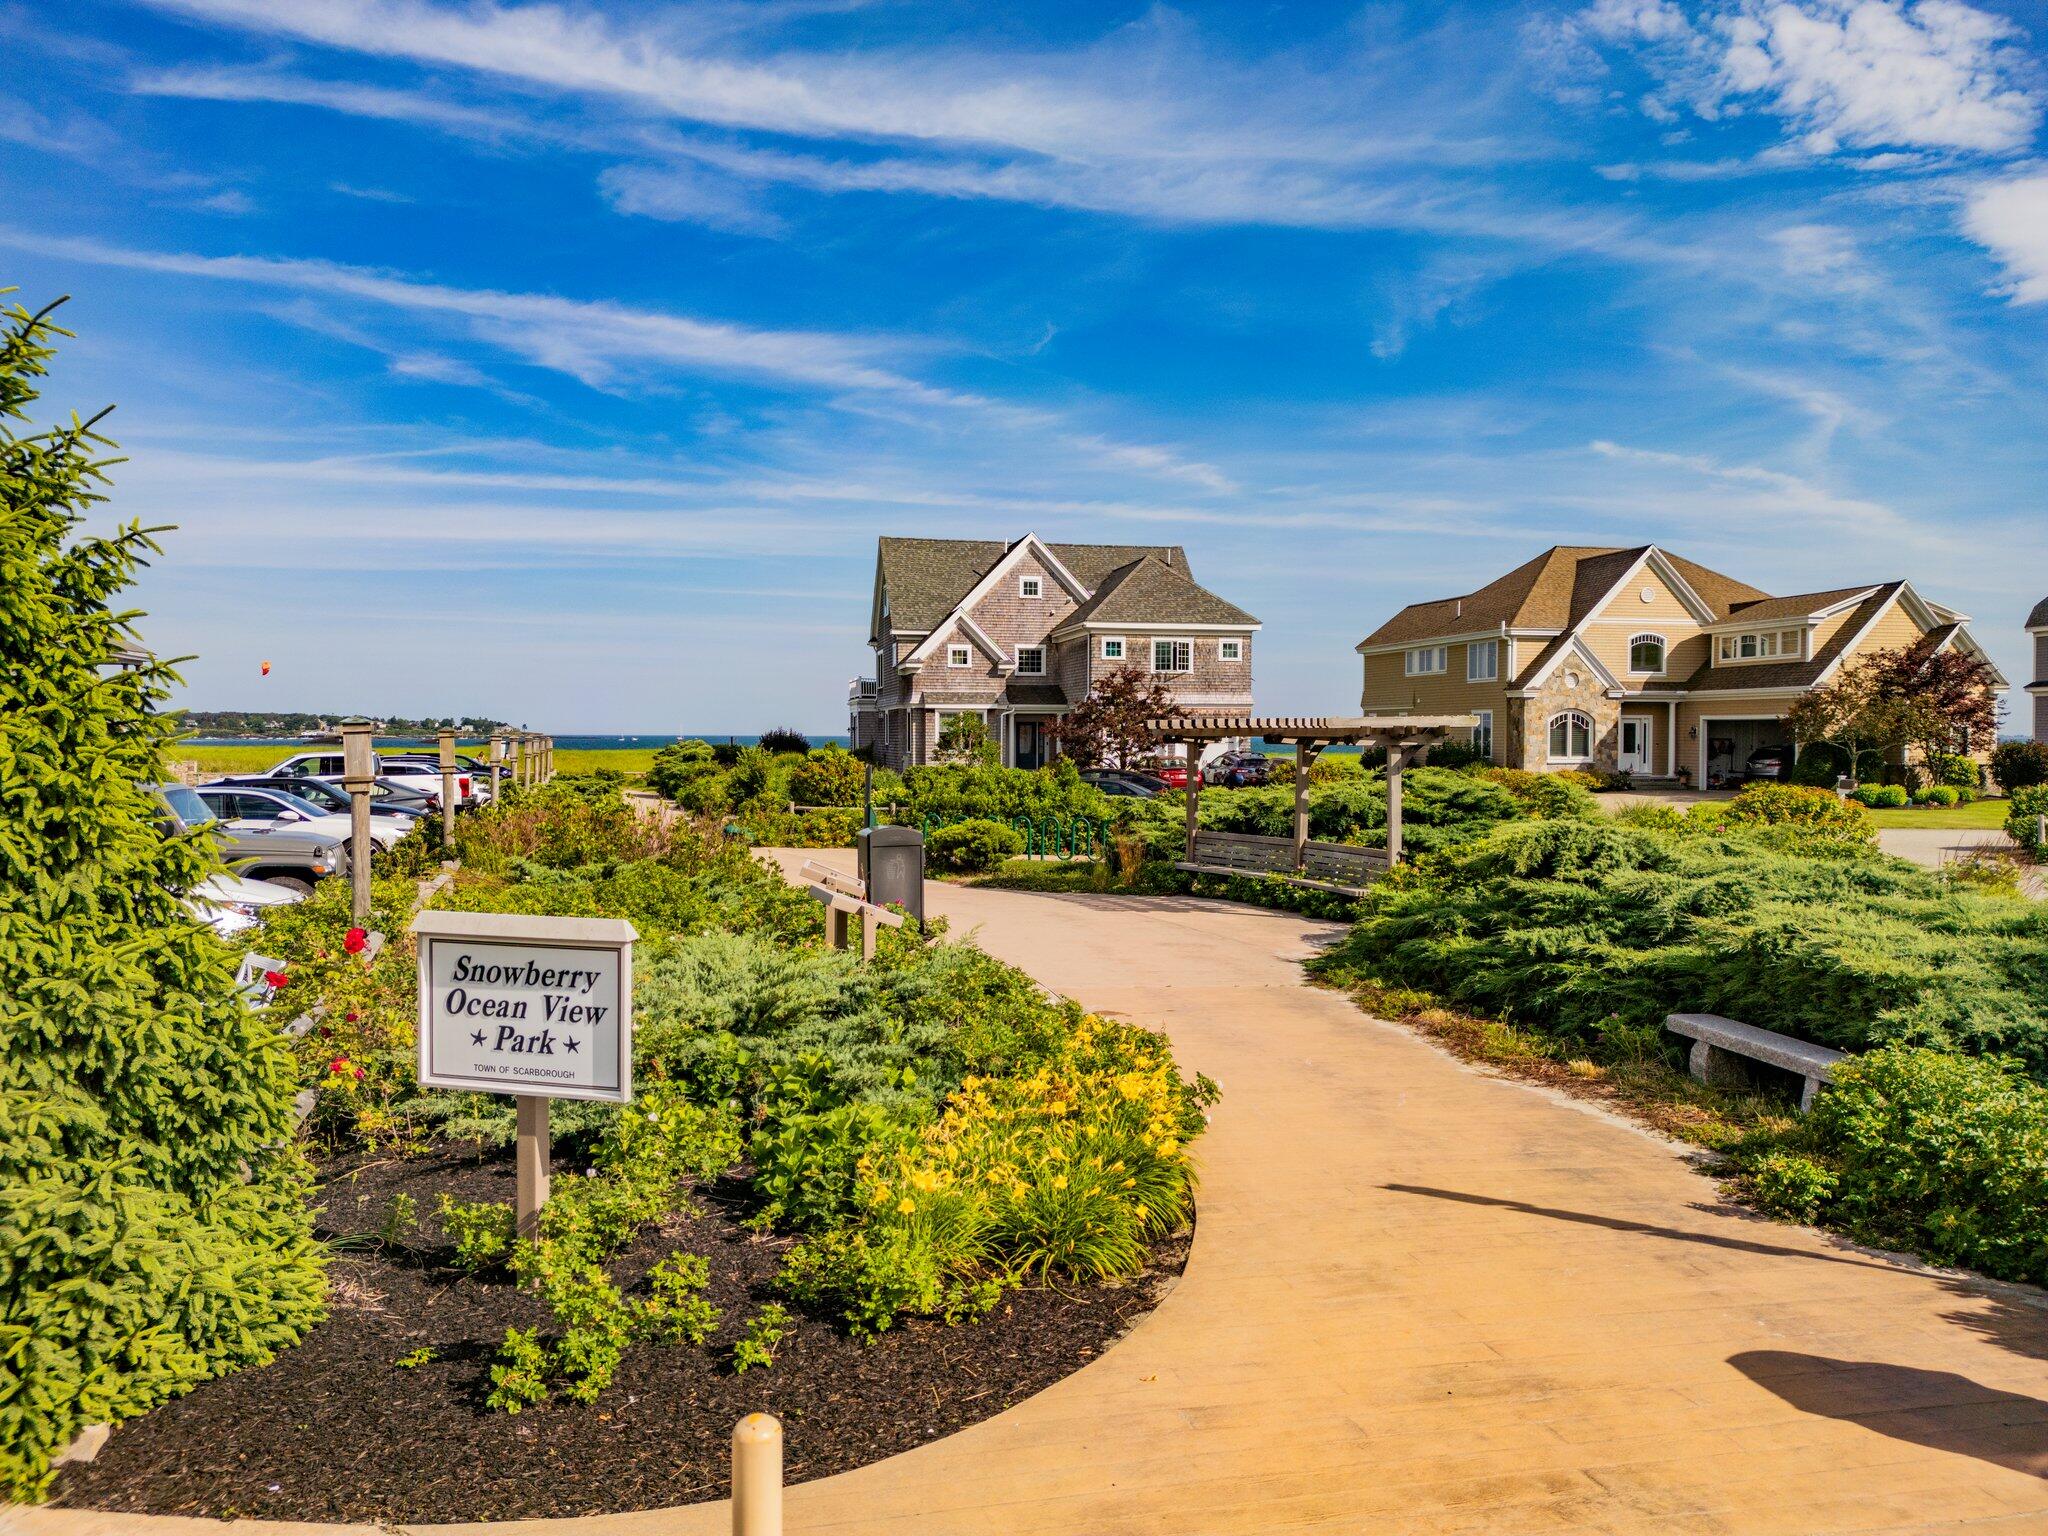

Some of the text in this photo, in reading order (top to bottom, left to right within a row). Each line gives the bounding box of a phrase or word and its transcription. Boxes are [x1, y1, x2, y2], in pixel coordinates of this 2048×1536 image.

[453, 955, 601, 994] Snowberry
[445, 988, 608, 1025] Ocean View
[493, 1025, 557, 1055] Park
[474, 1064, 575, 1079] TOWN OF SCARBOROUGH
